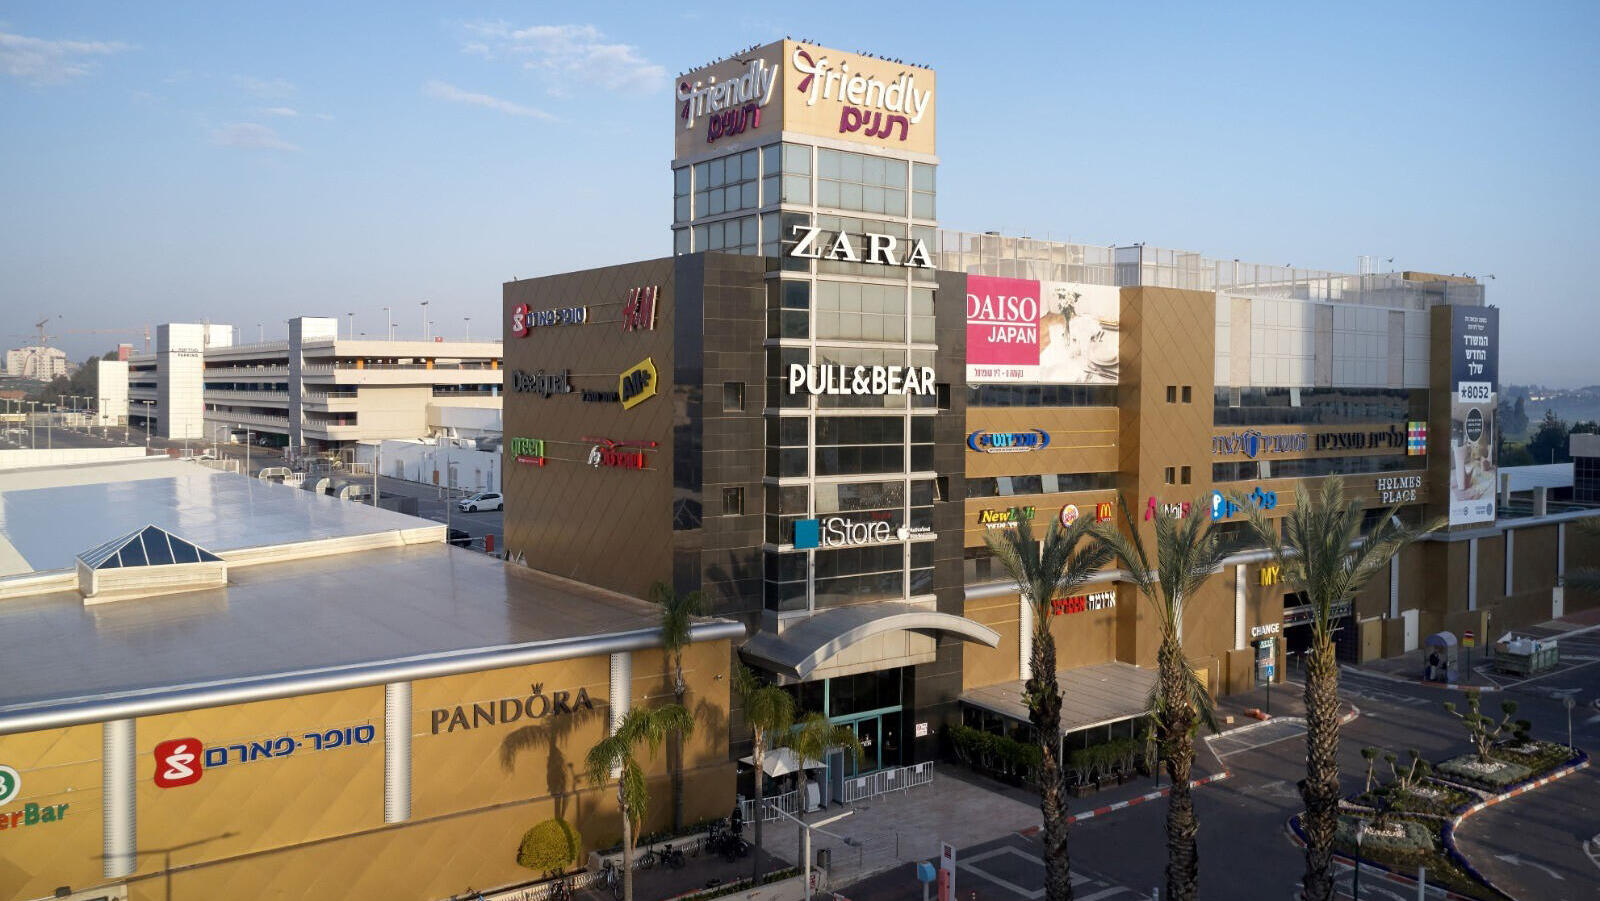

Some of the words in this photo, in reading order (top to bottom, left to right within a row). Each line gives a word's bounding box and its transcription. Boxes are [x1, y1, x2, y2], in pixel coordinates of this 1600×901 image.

[677, 58, 778, 129] friendly
[793, 48, 932, 124] friendly
[707, 103, 761, 143] תנים
[839, 106, 909, 141] תנים
[790, 224, 937, 269] ZARA
[967, 294, 1037, 322] DAISO
[988, 326, 1037, 344] JAPAN
[1464, 335, 1488, 346] המשרד
[1465, 349, 1486, 360] החדש
[1468, 361, 1483, 376] שלך
[789, 364, 936, 395] PULL&BEAR
[1378, 476, 1421, 491] HOLMES
[1383, 490, 1416, 504] PLACE
[821, 518, 890, 547] iStore
[1251, 623, 1280, 638] CHANGE
[431, 682, 595, 735] PANDORA
